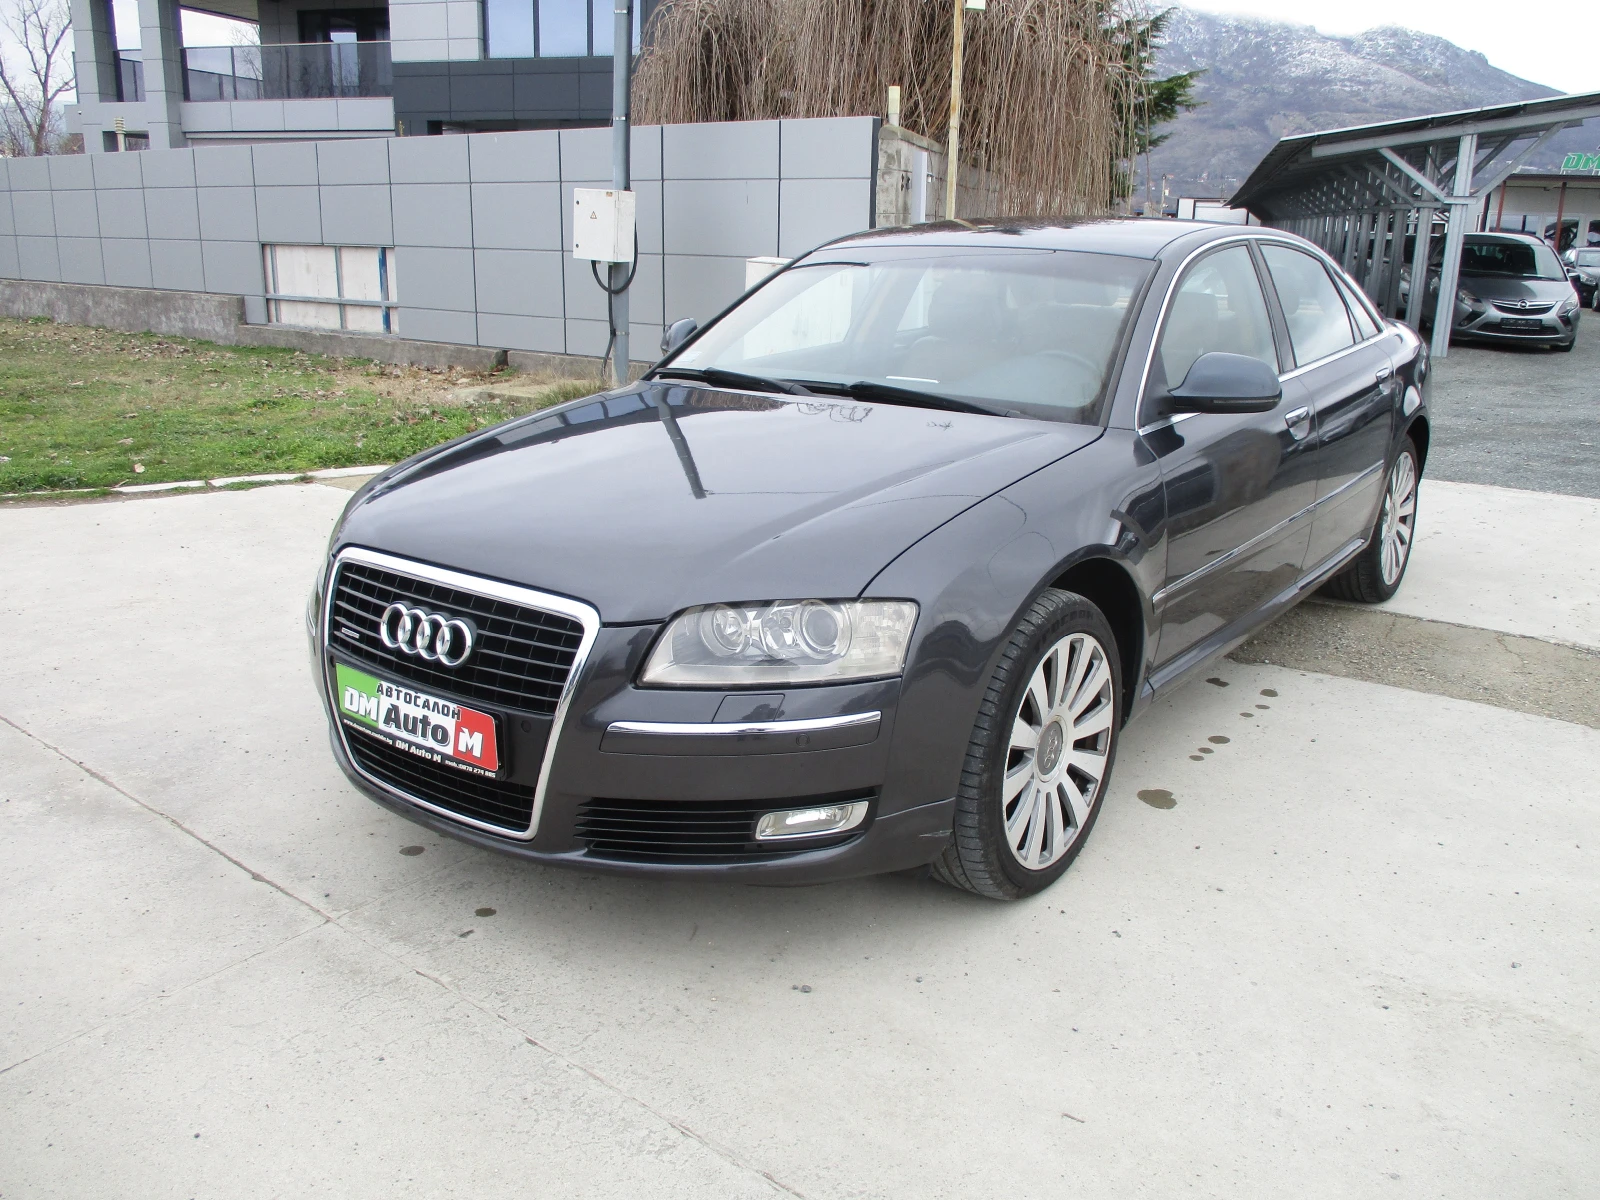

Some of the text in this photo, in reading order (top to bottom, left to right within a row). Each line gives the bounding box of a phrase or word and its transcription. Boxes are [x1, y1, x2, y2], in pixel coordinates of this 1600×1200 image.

[1560, 152, 1600, 170] DM
[376, 682, 462, 721] АВТОСАЛОН
[344, 686, 378, 723] DM
[383, 703, 450, 747] Auto
[457, 726, 483, 759] M
[395, 740, 409, 751] DM
[410, 745, 432, 760] Auto
[433, 753, 442, 763] M
